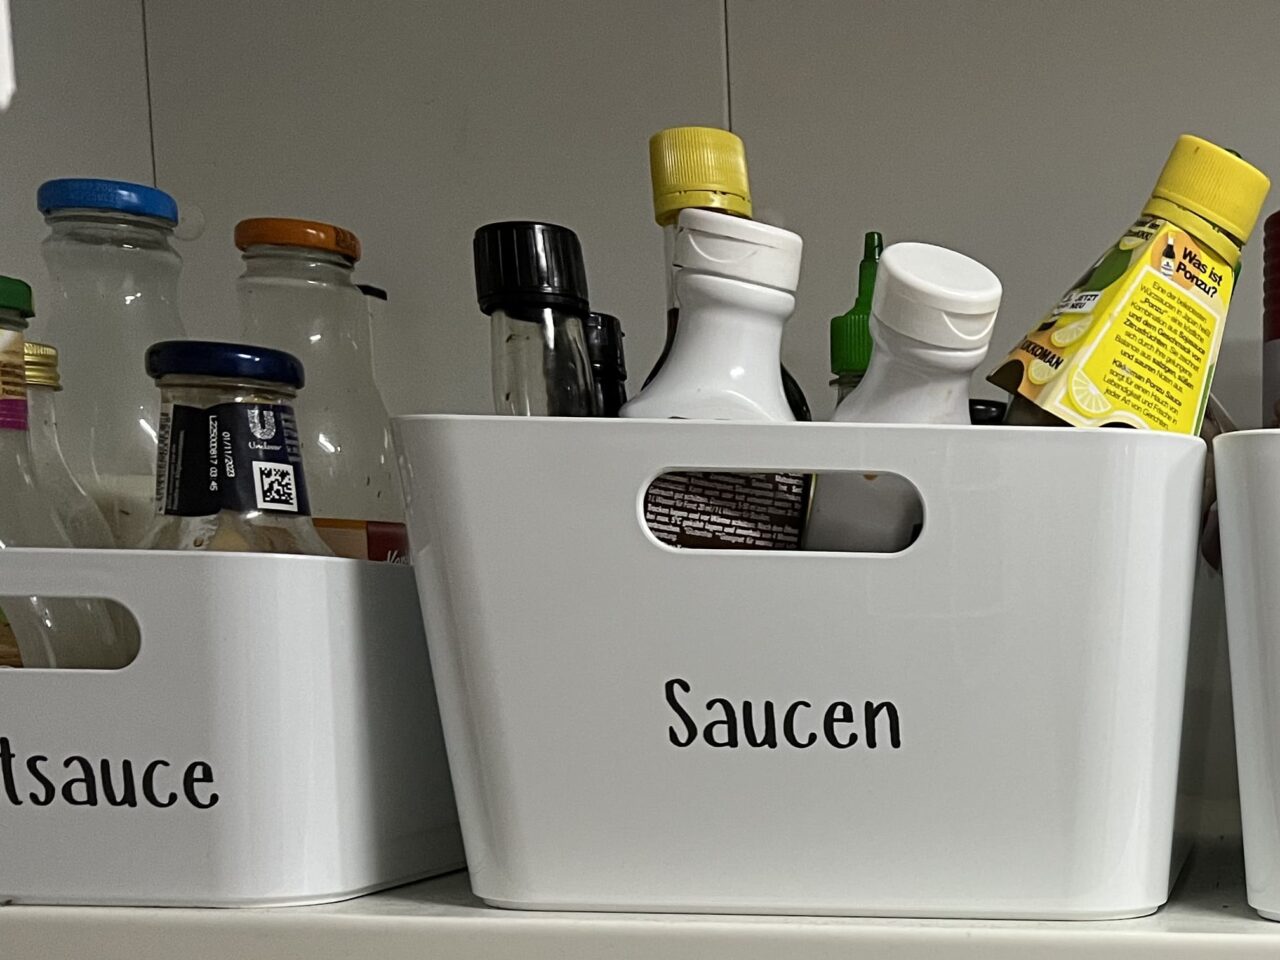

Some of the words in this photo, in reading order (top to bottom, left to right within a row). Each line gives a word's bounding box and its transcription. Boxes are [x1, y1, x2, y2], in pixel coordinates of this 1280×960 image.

[1176, 262, 1217, 298] Ponzu?
[1182, 247, 1209, 273] Was
[1208, 266, 1224, 286] ist
[1151, 281, 1167, 295] Eine
[1165, 291, 1176, 301] der
[1127, 310, 1142, 323] und
[1141, 319, 1157, 332] dem
[1190, 351, 1203, 362] von
[1136, 337, 1155, 353] durch
[1119, 348, 1134, 361] und
[1133, 357, 1156, 375] sauren
[1155, 371, 1173, 386] Noten
[1139, 397, 1153, 409] und
[1143, 378, 1165, 395] Ponzu
[1163, 390, 1184, 406] Sauce
[221, 431, 236, 478] 01/11/2023
[665, 679, 900, 749] Saucen
[0, 737, 219, 809] tsauce
